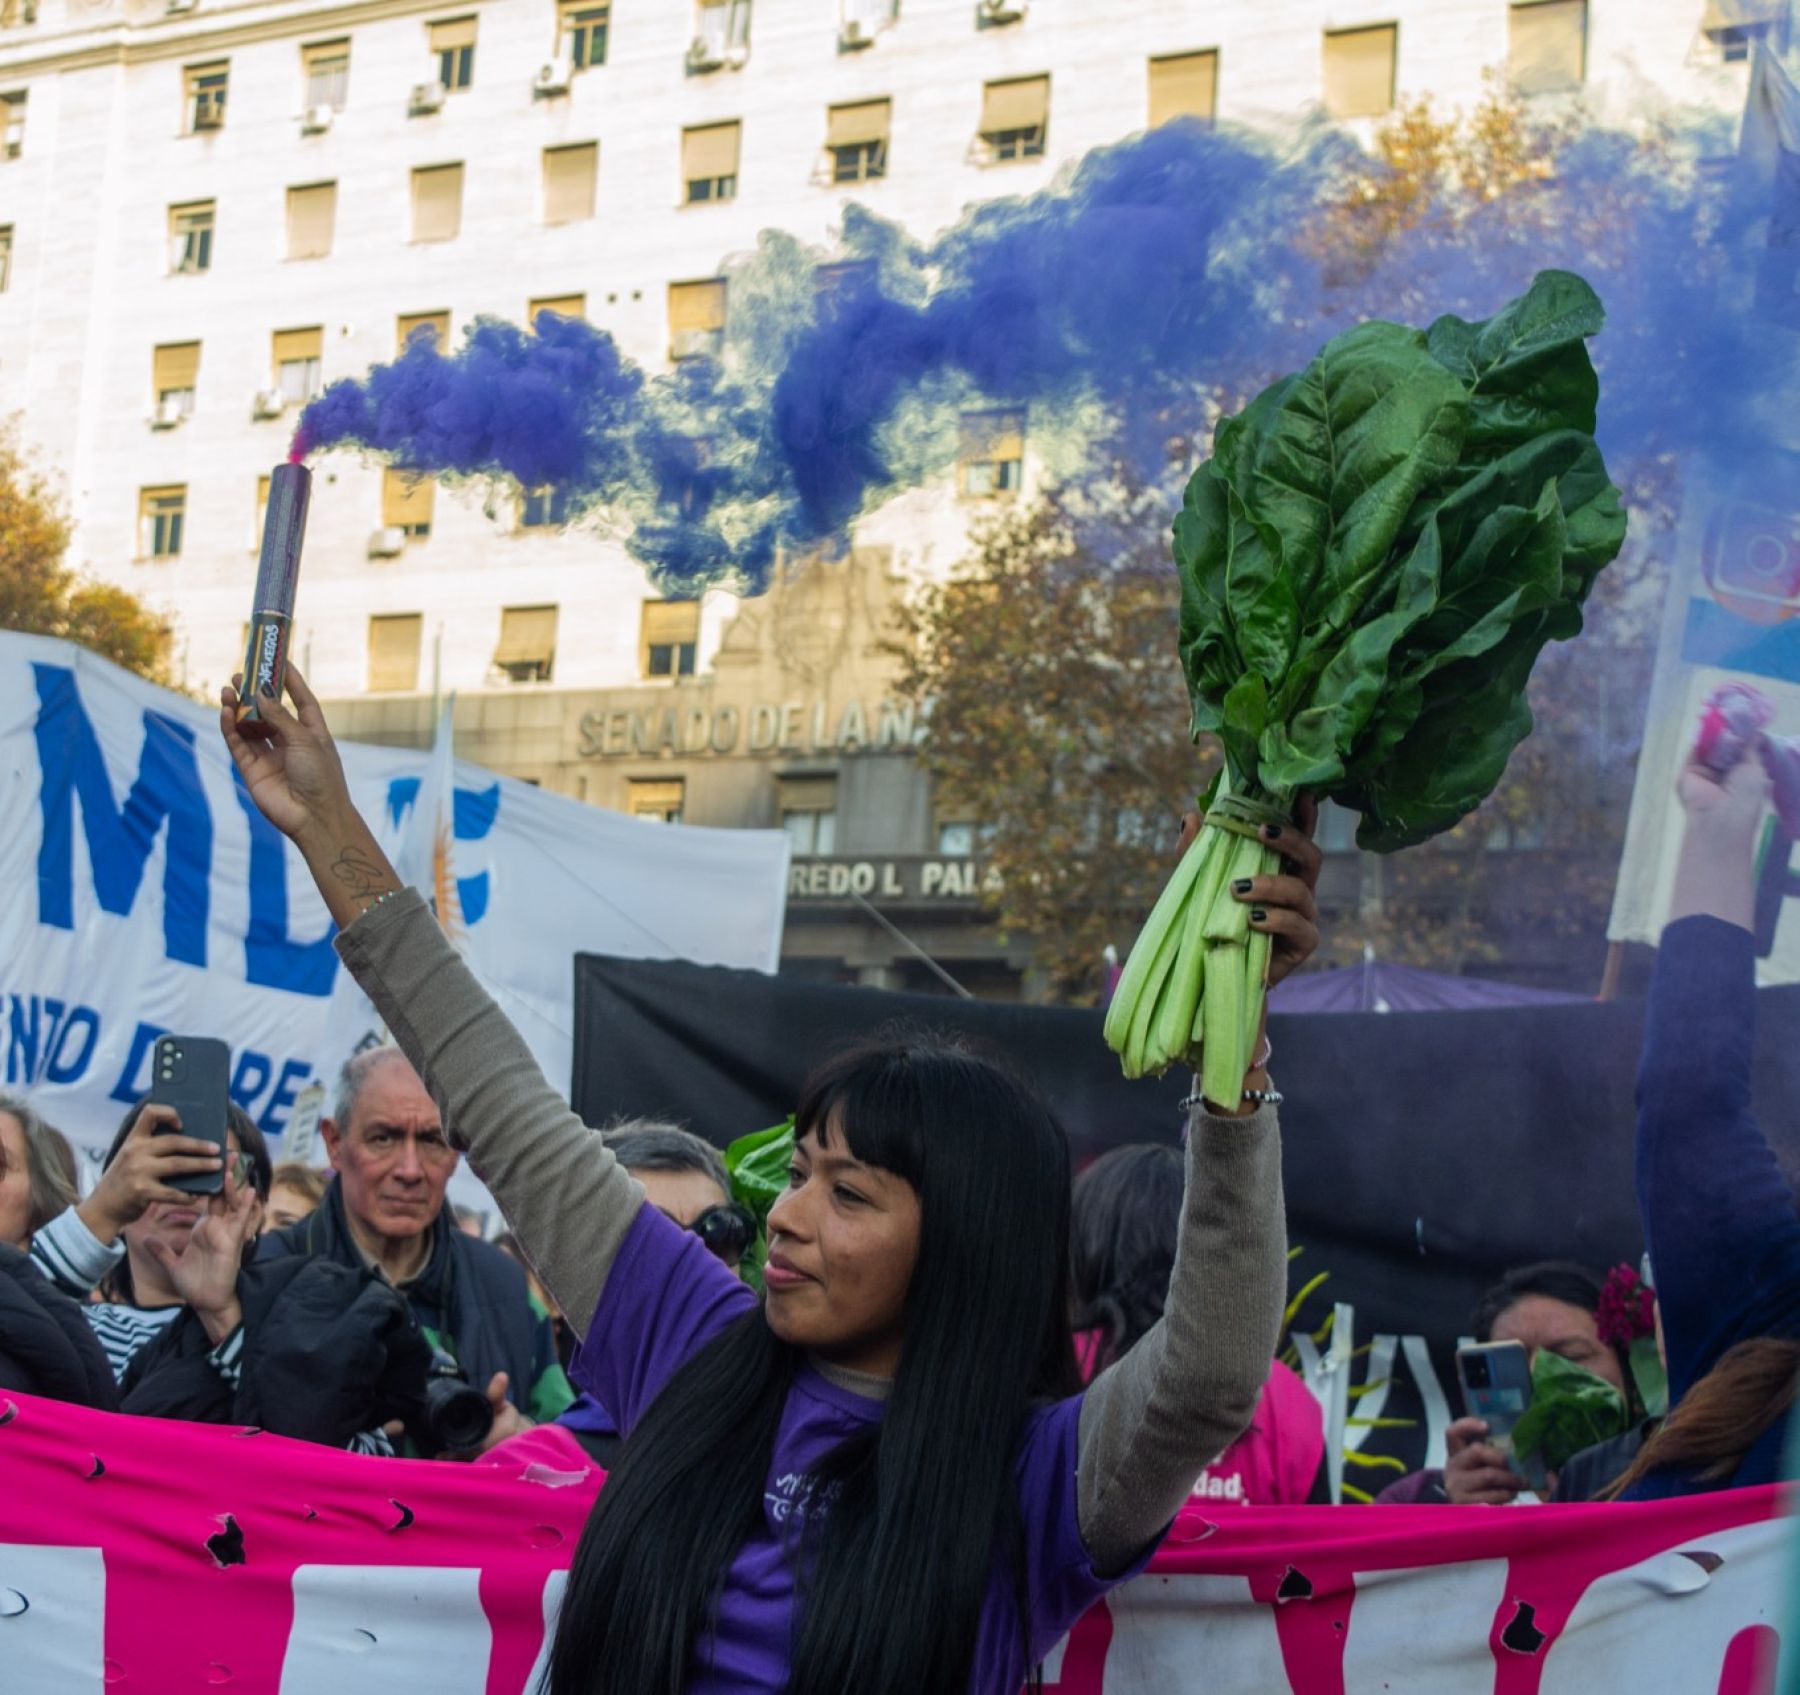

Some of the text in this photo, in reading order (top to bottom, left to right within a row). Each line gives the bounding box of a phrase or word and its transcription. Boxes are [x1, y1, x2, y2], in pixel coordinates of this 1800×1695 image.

[577, 705, 739, 757] SENADO
[748, 702, 801, 753] DE
[811, 698, 869, 751] LA
[882, 863, 903, 896] L
